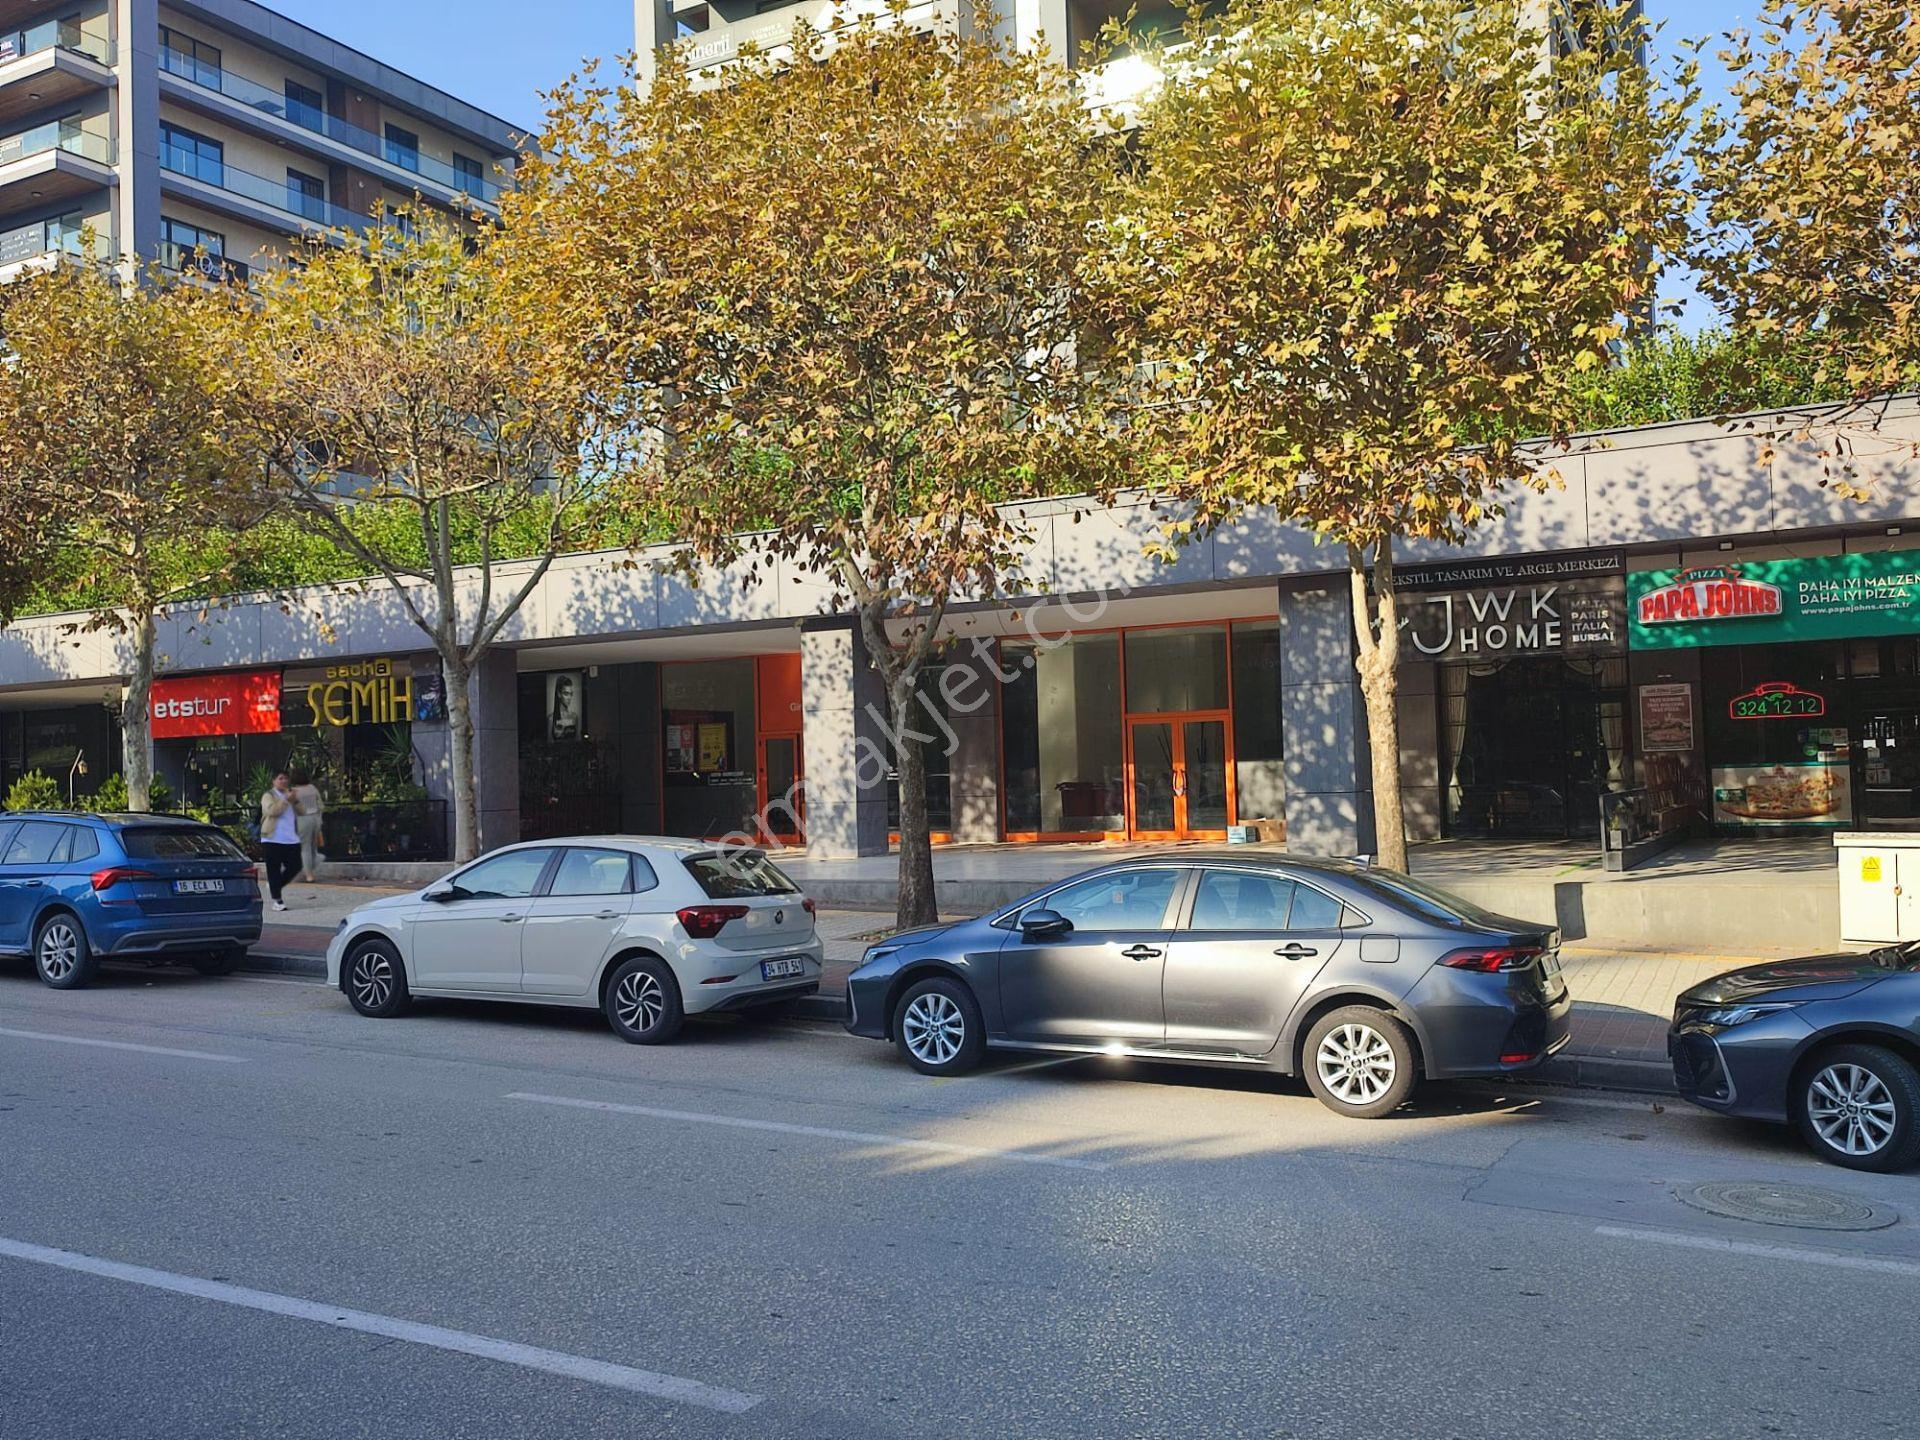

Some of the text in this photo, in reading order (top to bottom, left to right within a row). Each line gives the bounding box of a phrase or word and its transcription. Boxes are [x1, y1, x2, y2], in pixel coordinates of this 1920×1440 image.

[1391, 572, 1434, 586] EKSTİL
[1435, 567, 1494, 583] TASARIM
[1495, 565, 1515, 578] VE
[1516, 562, 1555, 576] ARGE
[1557, 554, 1621, 573] MERKEZİ
[1688, 569, 1726, 580] PIZZA
[1799, 580, 1840, 593] DAHA
[1641, 583, 1778, 620] PAPA JOHNS
[1800, 592, 1841, 605] DAHA
[1571, 609, 1609, 620] PARIS
[1801, 601, 1911, 615] www.papajohns.com.tr
[1572, 621, 1610, 631] ITALIA
[1459, 621, 1562, 653] HOME
[325, 658, 391, 678] sacha
[154, 696, 232, 719] etstur
[1738, 698, 1817, 716] 324 12 12
